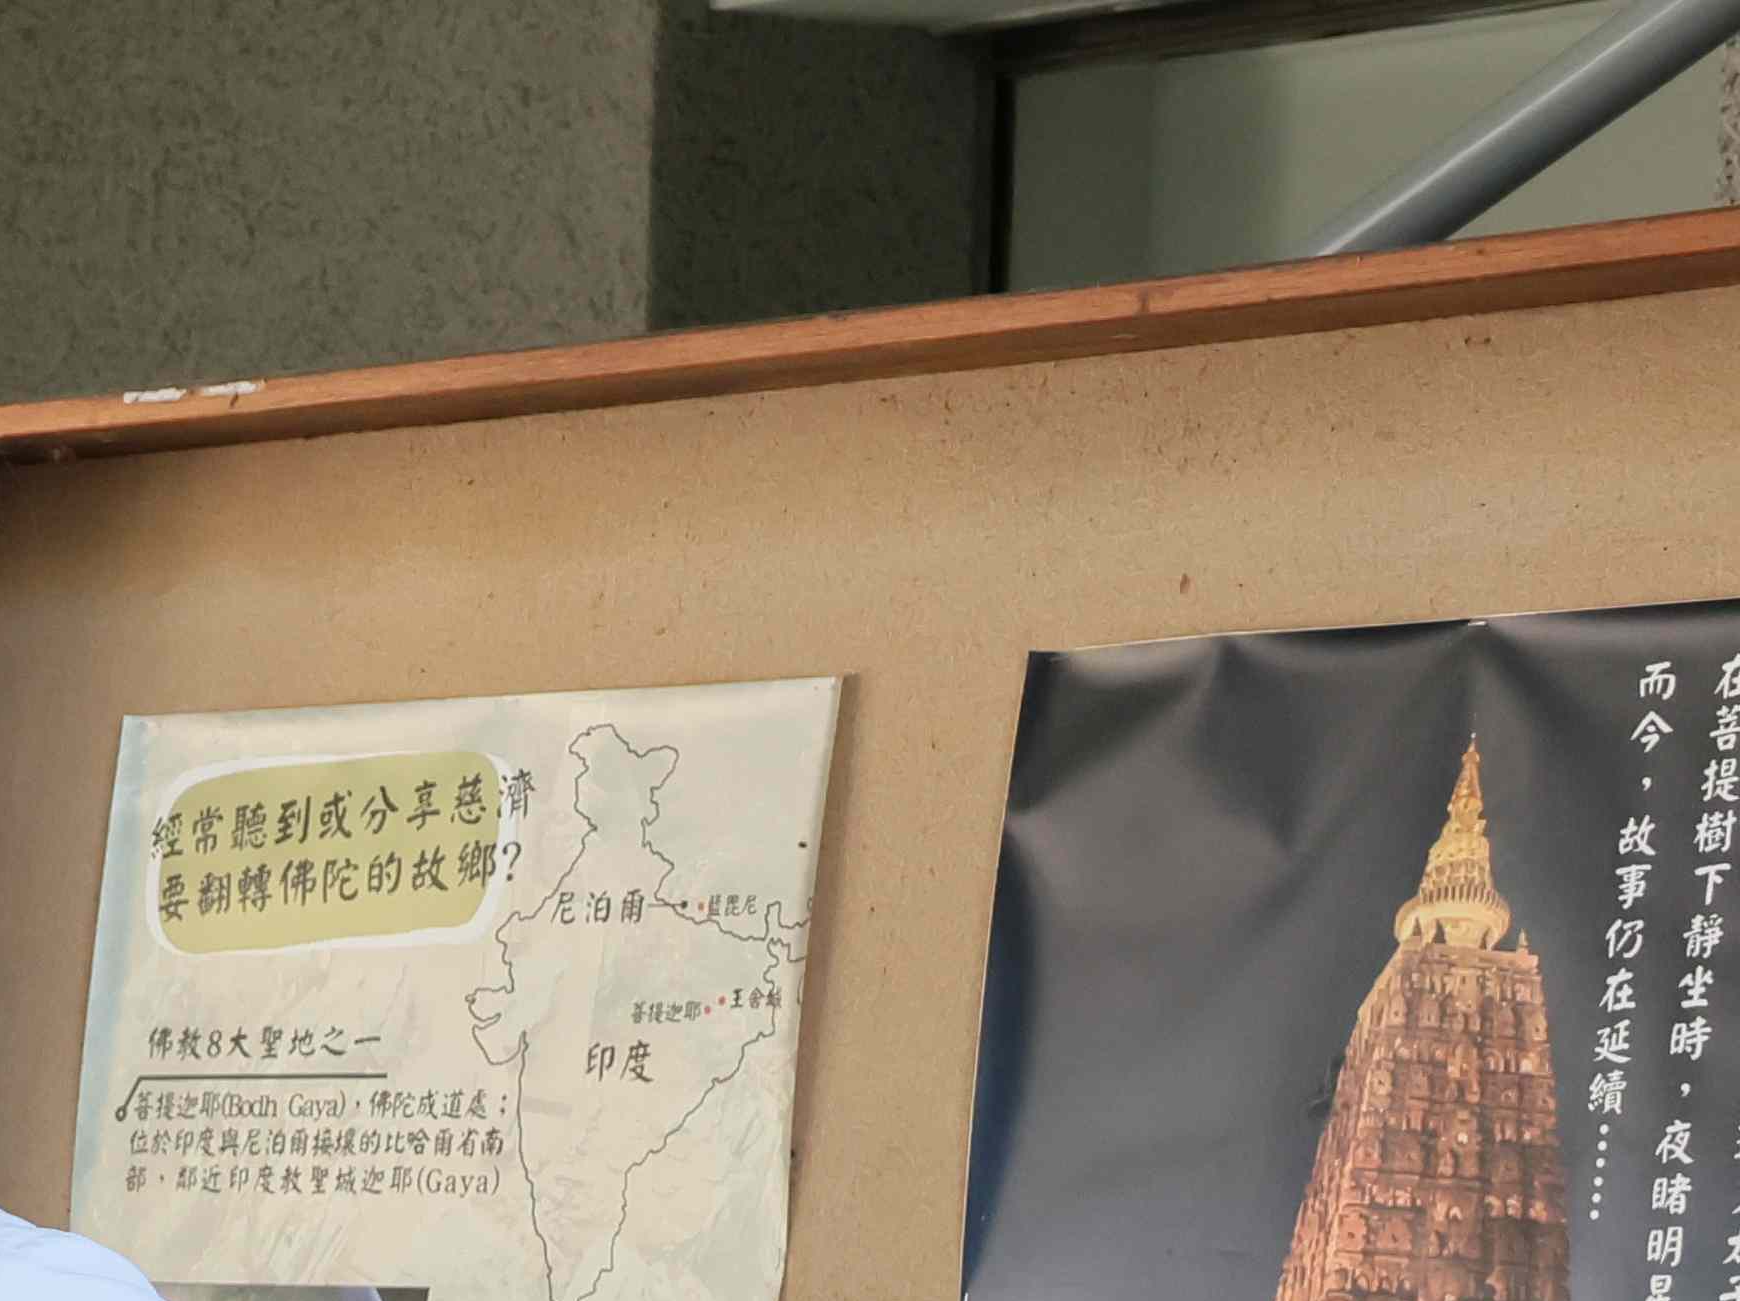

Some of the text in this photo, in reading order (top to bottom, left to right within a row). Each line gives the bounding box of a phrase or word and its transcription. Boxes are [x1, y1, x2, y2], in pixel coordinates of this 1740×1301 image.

[151, 768, 538, 860] 經常聽到或分享慈濟
[157, 841, 523, 923] 要翻轉佛陀的故鄉?
[550, 888, 646, 926] 尼泊爾
[631, 1000, 702, 1024] 菩提迦耶
[147, 1024, 381, 1060] 佛教8大聖地之一
[585, 1039, 654, 1083] 印度
